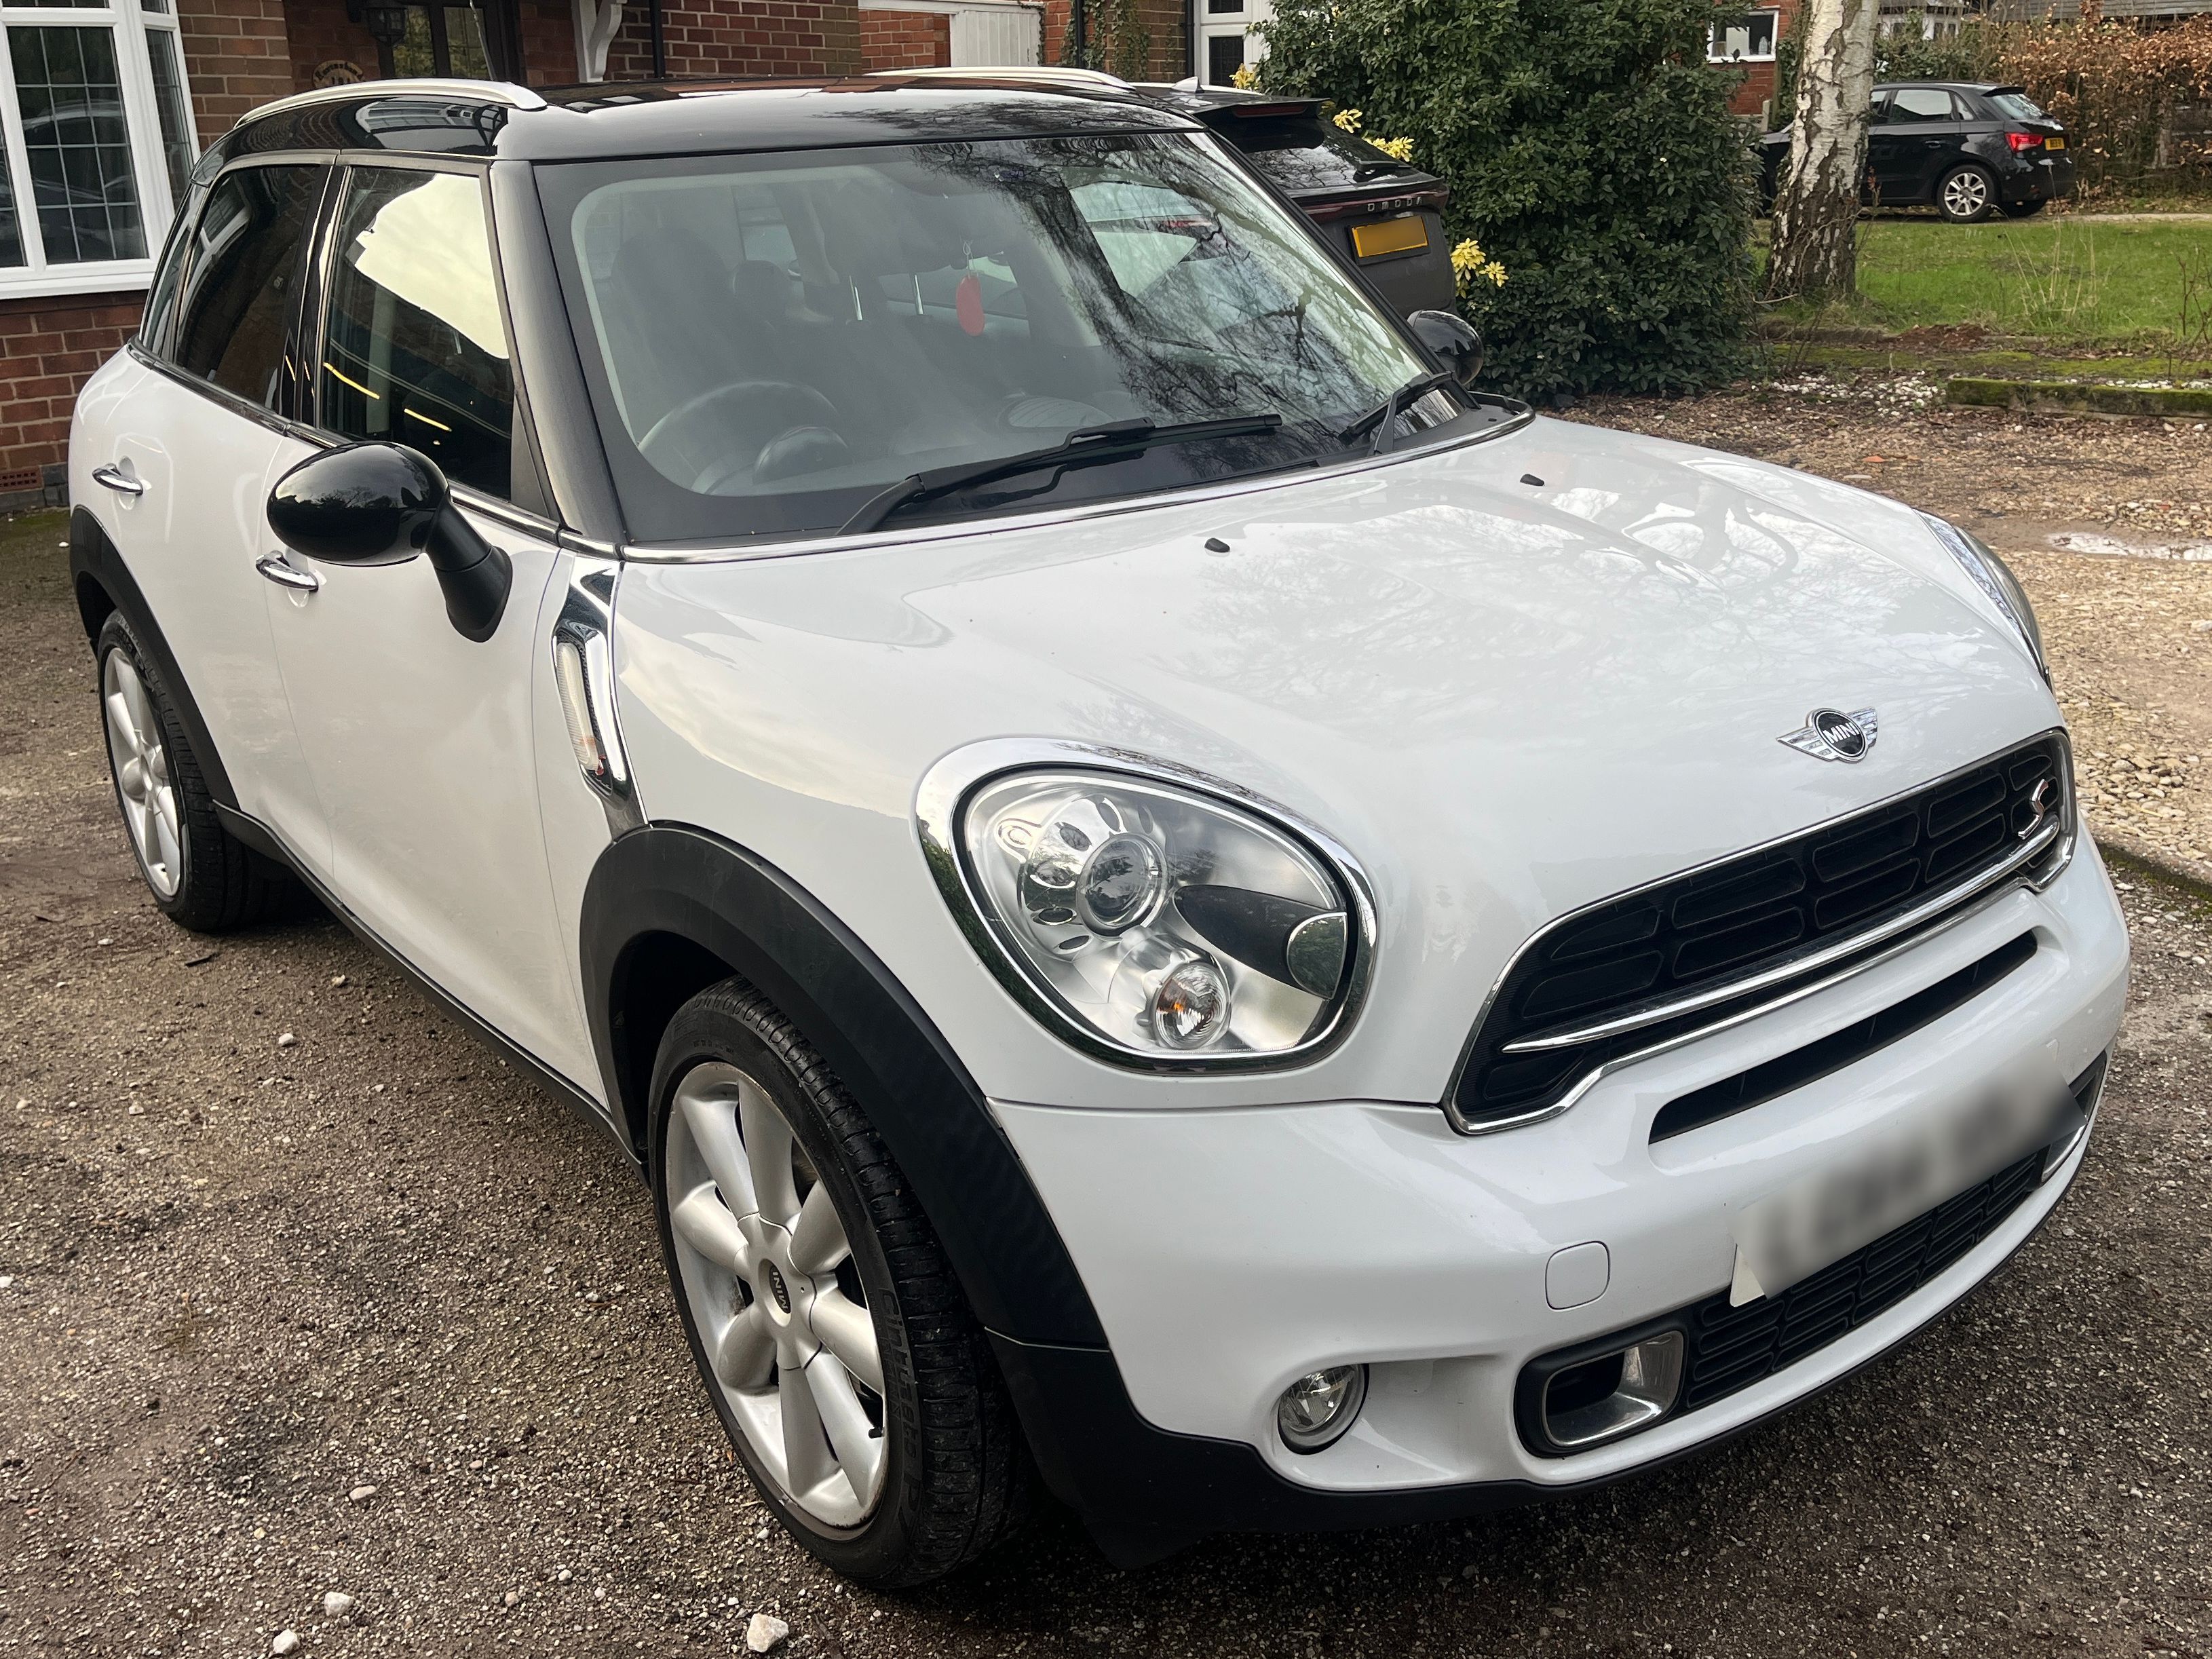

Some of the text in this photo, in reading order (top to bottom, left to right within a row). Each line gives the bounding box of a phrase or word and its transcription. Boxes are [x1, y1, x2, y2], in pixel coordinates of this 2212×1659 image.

[1823, 721, 1860, 744] MINI
[2018, 778, 2048, 840] S
[772, 1271, 788, 1310] MINI
